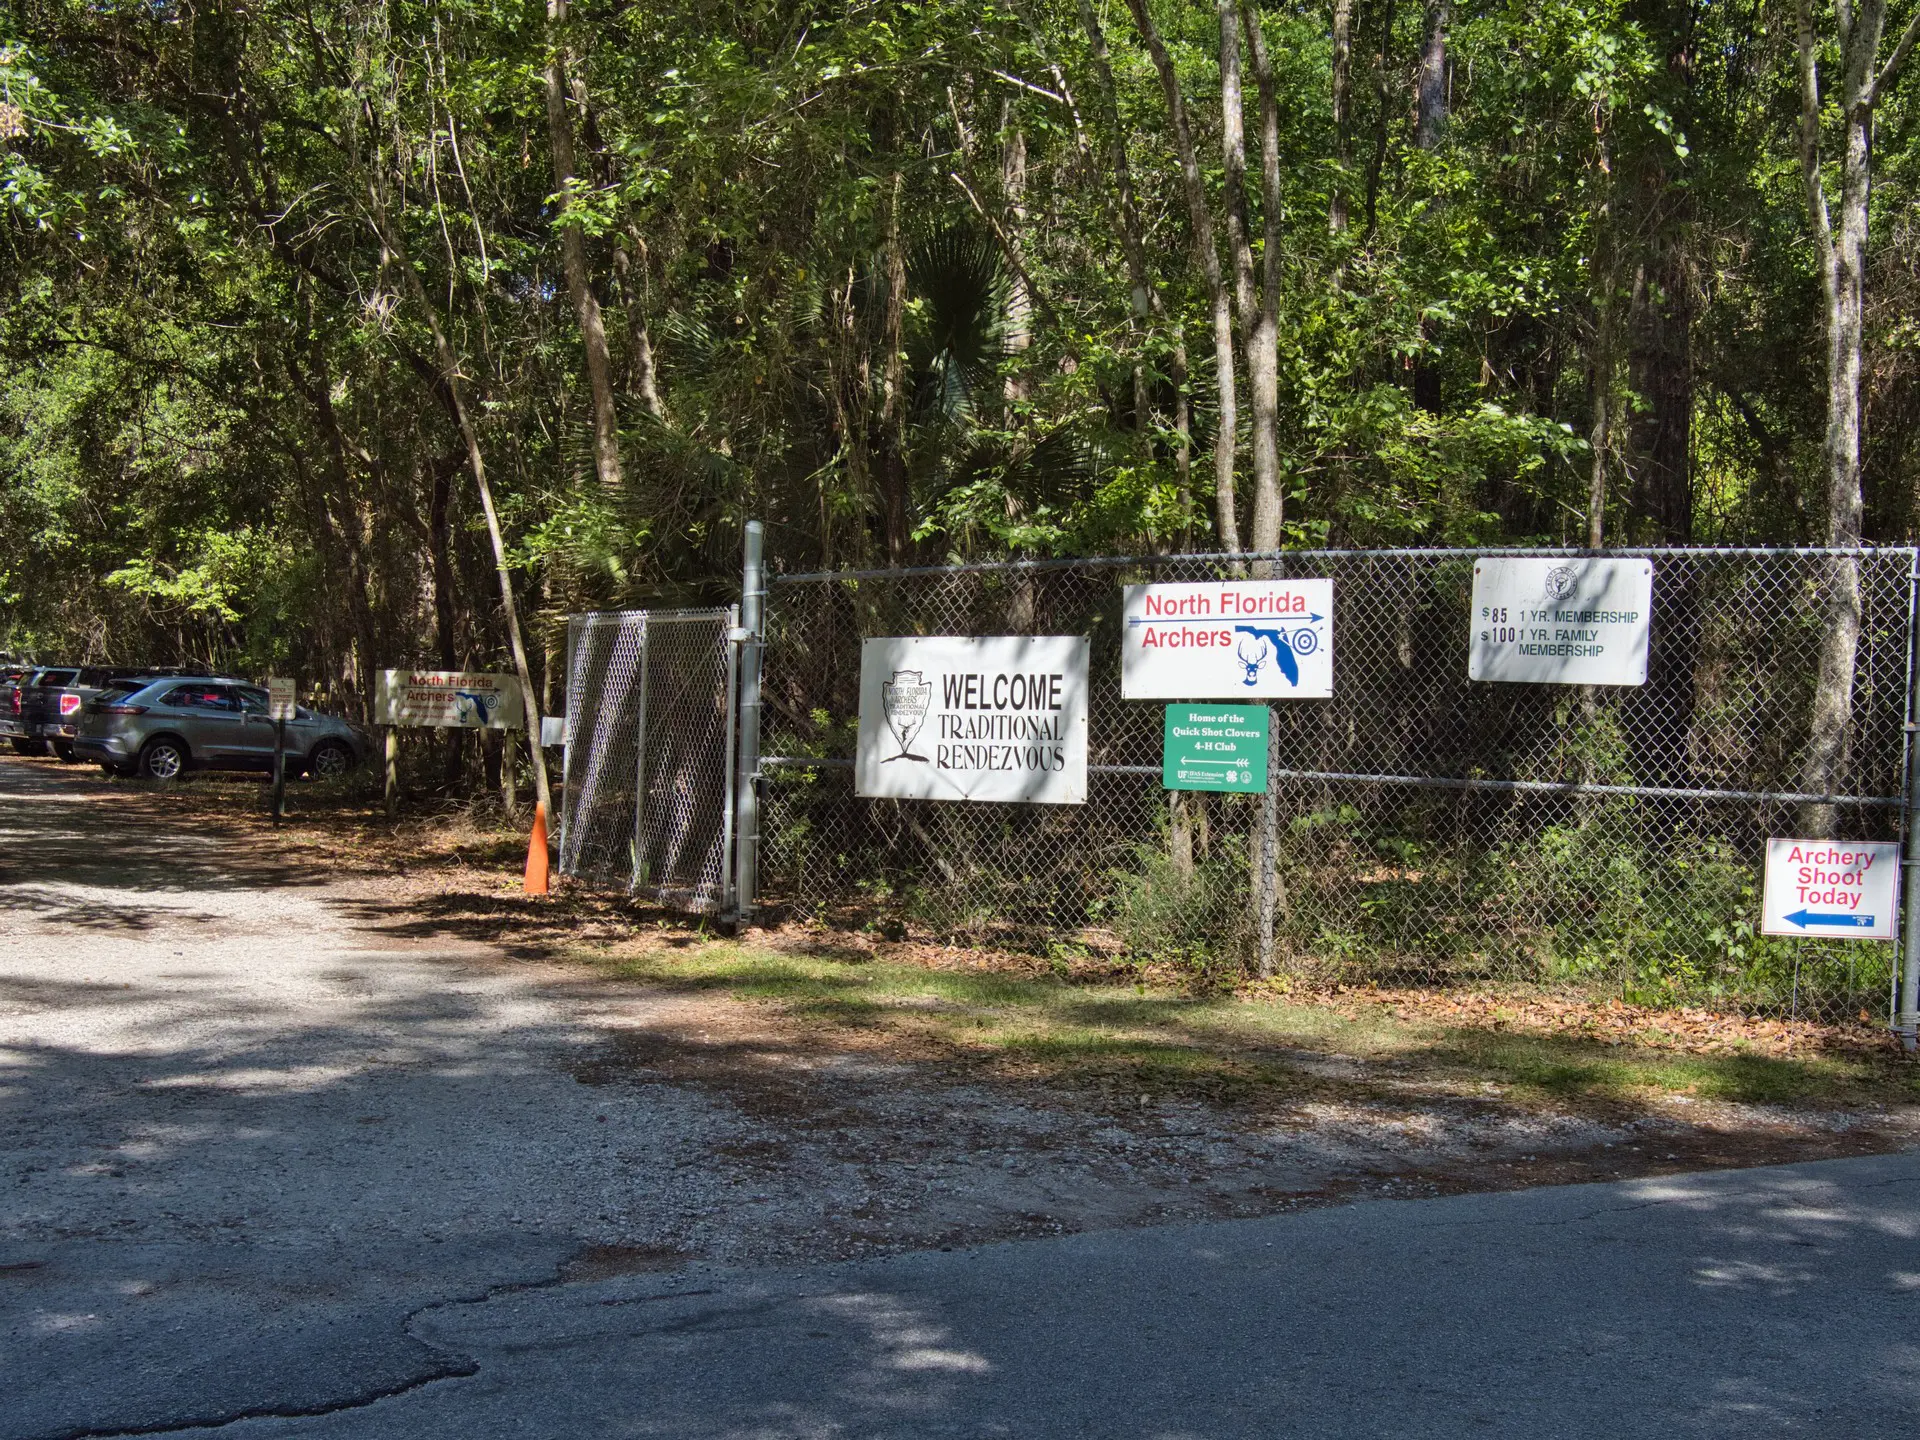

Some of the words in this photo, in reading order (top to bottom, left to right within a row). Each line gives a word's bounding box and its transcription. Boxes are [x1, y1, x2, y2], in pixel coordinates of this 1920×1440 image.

[1145, 593, 1211, 616] North
[1220, 591, 1306, 614] Florida
[1520, 611, 1525, 622] 1
[1530, 610, 1550, 623] YR.
[1554, 610, 1639, 624] MEMBERSHIP
[1142, 626, 1232, 648] Archers
[1519, 629, 1524, 641] 1
[1529, 629, 1550, 641] YR.
[1555, 629, 1599, 642] FAMILY
[1518, 644, 1604, 657] MEMBERSHIP
[408, 675, 443, 687] North
[448, 676, 493, 688] Florida
[406, 689, 455, 702] Archers
[942, 673, 1063, 711] WELCOME
[1189, 713, 1216, 723] Home
[1217, 713, 1229, 723] of
[1229, 714, 1245, 723] the
[937, 714, 1064, 741] TRADITIONAL
[1172, 726, 1200, 737] Quick
[1201, 727, 1223, 737] Shot
[1224, 728, 1260, 738] Clovers
[1194, 741, 1213, 751] 4-H
[1214, 742, 1237, 751] Club
[936, 744, 1065, 772] RENDEZVOUS
[1177, 770, 1188, 779] UF
[1787, 846, 1876, 870] Archery
[1797, 866, 1863, 886] Shoot
[1796, 886, 1862, 910] Today
